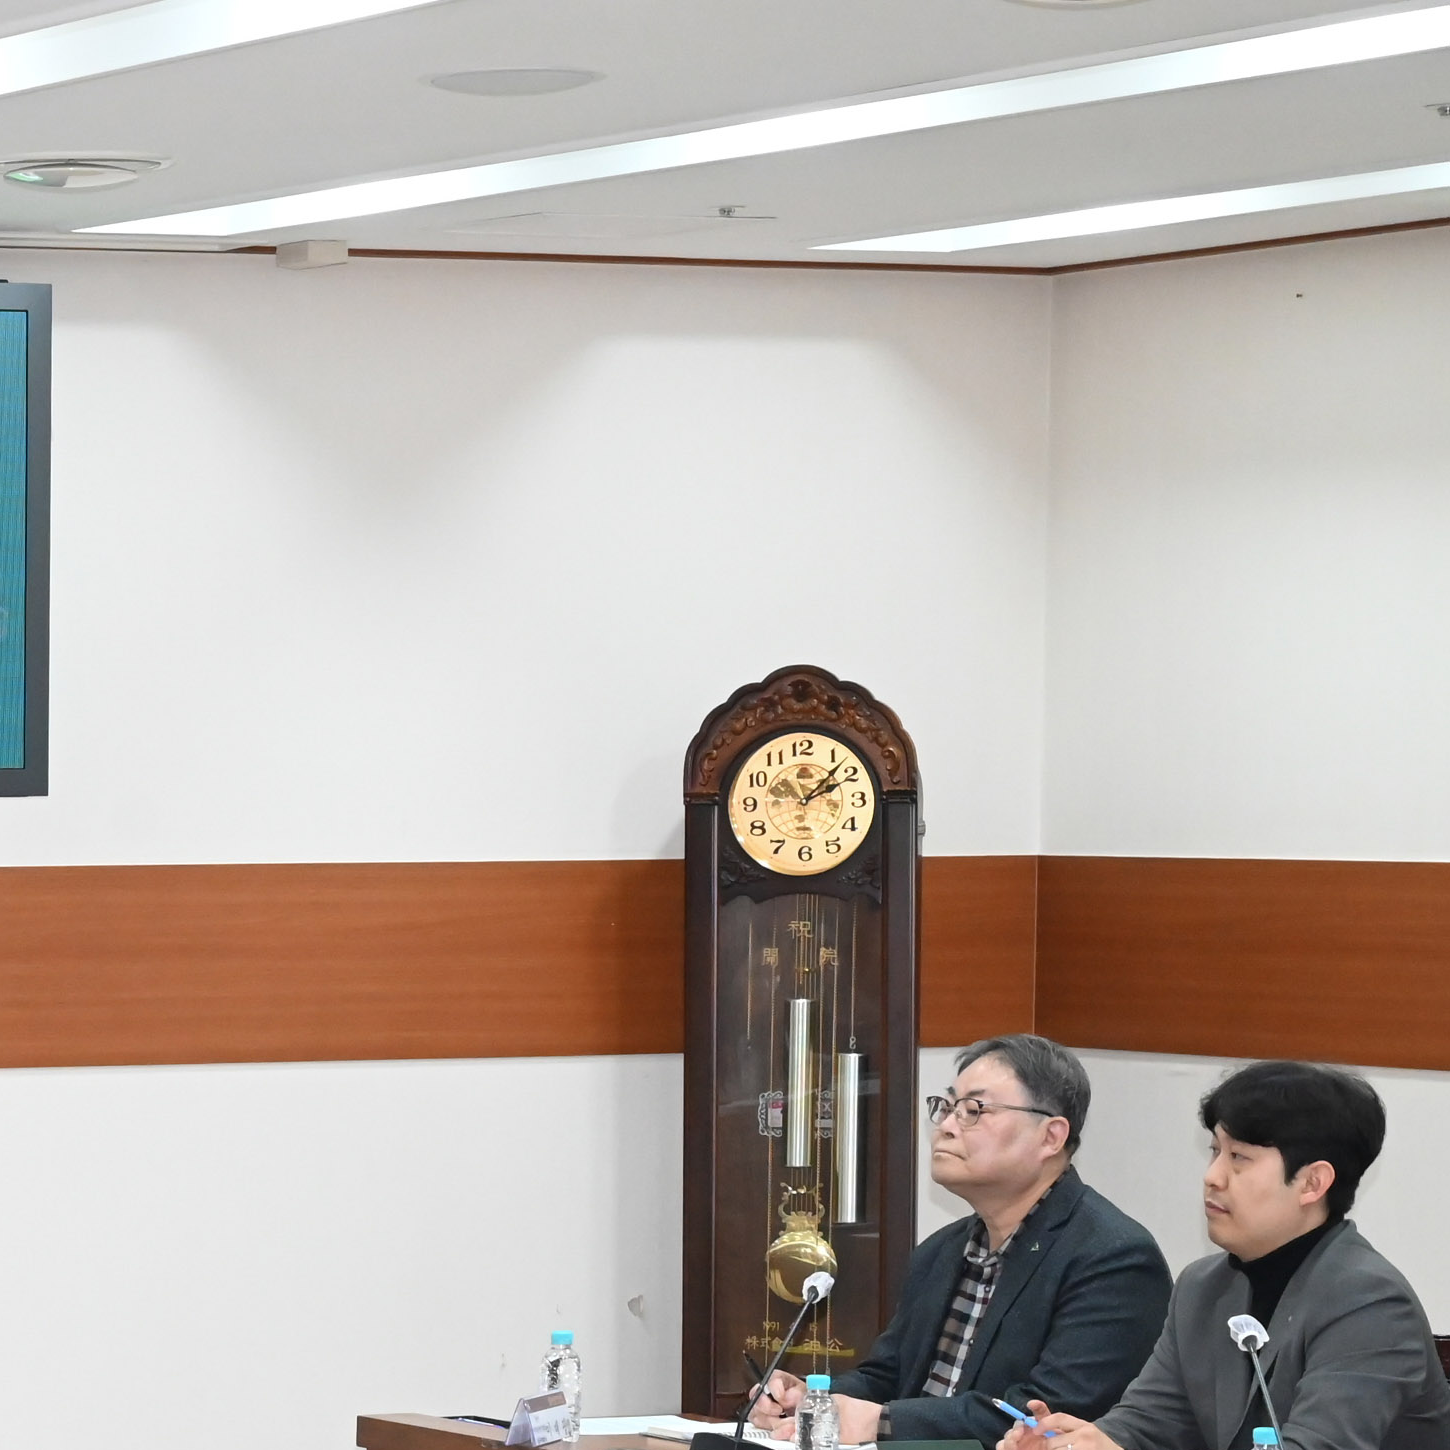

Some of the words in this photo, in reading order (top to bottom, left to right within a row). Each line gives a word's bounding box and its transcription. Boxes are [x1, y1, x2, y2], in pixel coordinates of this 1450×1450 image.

[791, 739, 814, 757] 12
[829, 748, 837, 763] 1
[766, 749, 785, 767] 11
[748, 771, 768, 788] 10
[844, 766, 859, 782] 2
[743, 797, 758, 813] 9
[851, 791, 867, 808] 3
[750, 820, 767, 837] 8
[841, 816, 858, 832] 4
[770, 839, 786, 855] 7
[825, 836, 842, 854] 5
[798, 846, 813, 861] 6
